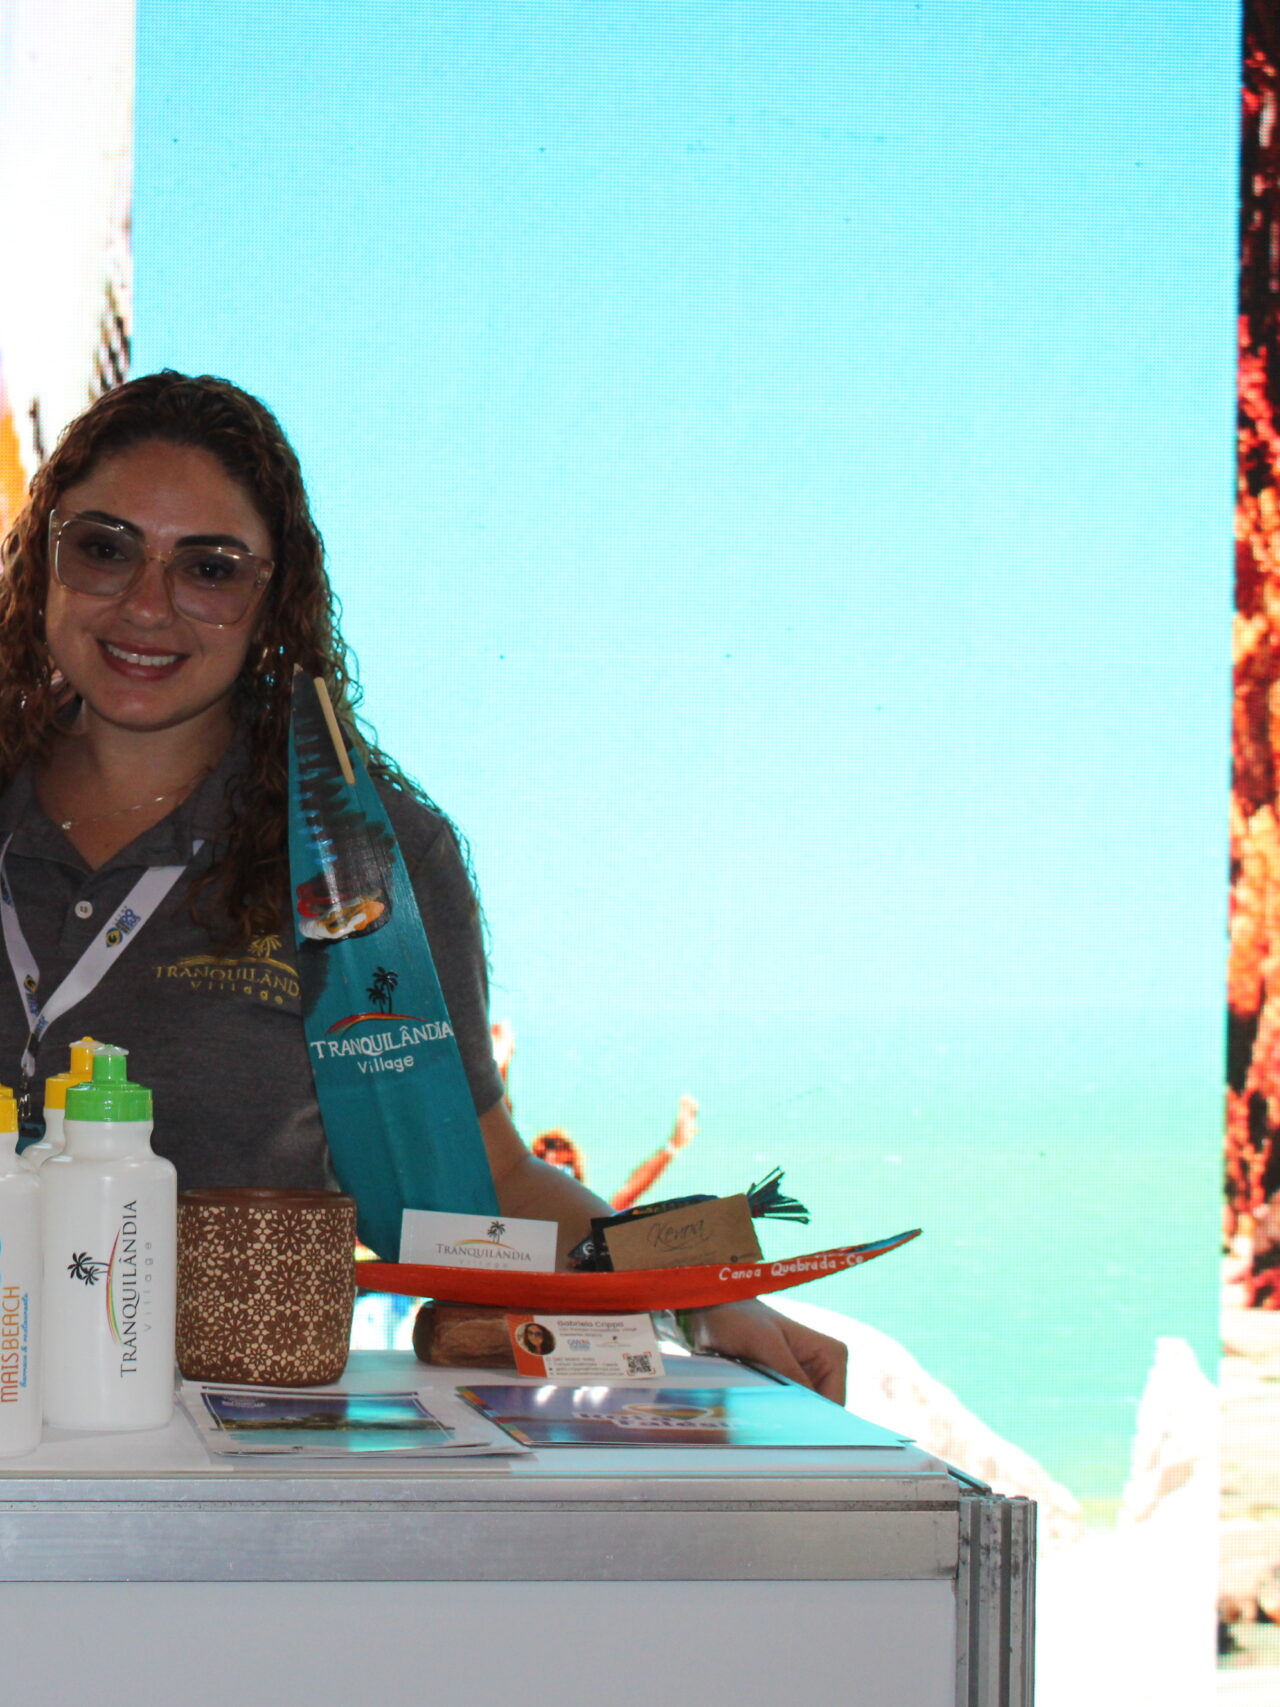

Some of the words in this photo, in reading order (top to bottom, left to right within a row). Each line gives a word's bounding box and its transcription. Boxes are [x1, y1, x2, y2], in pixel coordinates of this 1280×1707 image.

[310, 1021, 455, 1059] TRANQUILÂNDIA
[357, 1055, 415, 1074] Village
[718, 1267, 762, 1280] Canoa
[771, 1255, 836, 1277] Quebrada
[120, 1200, 139, 1378] TRANQUILÂNDIA
